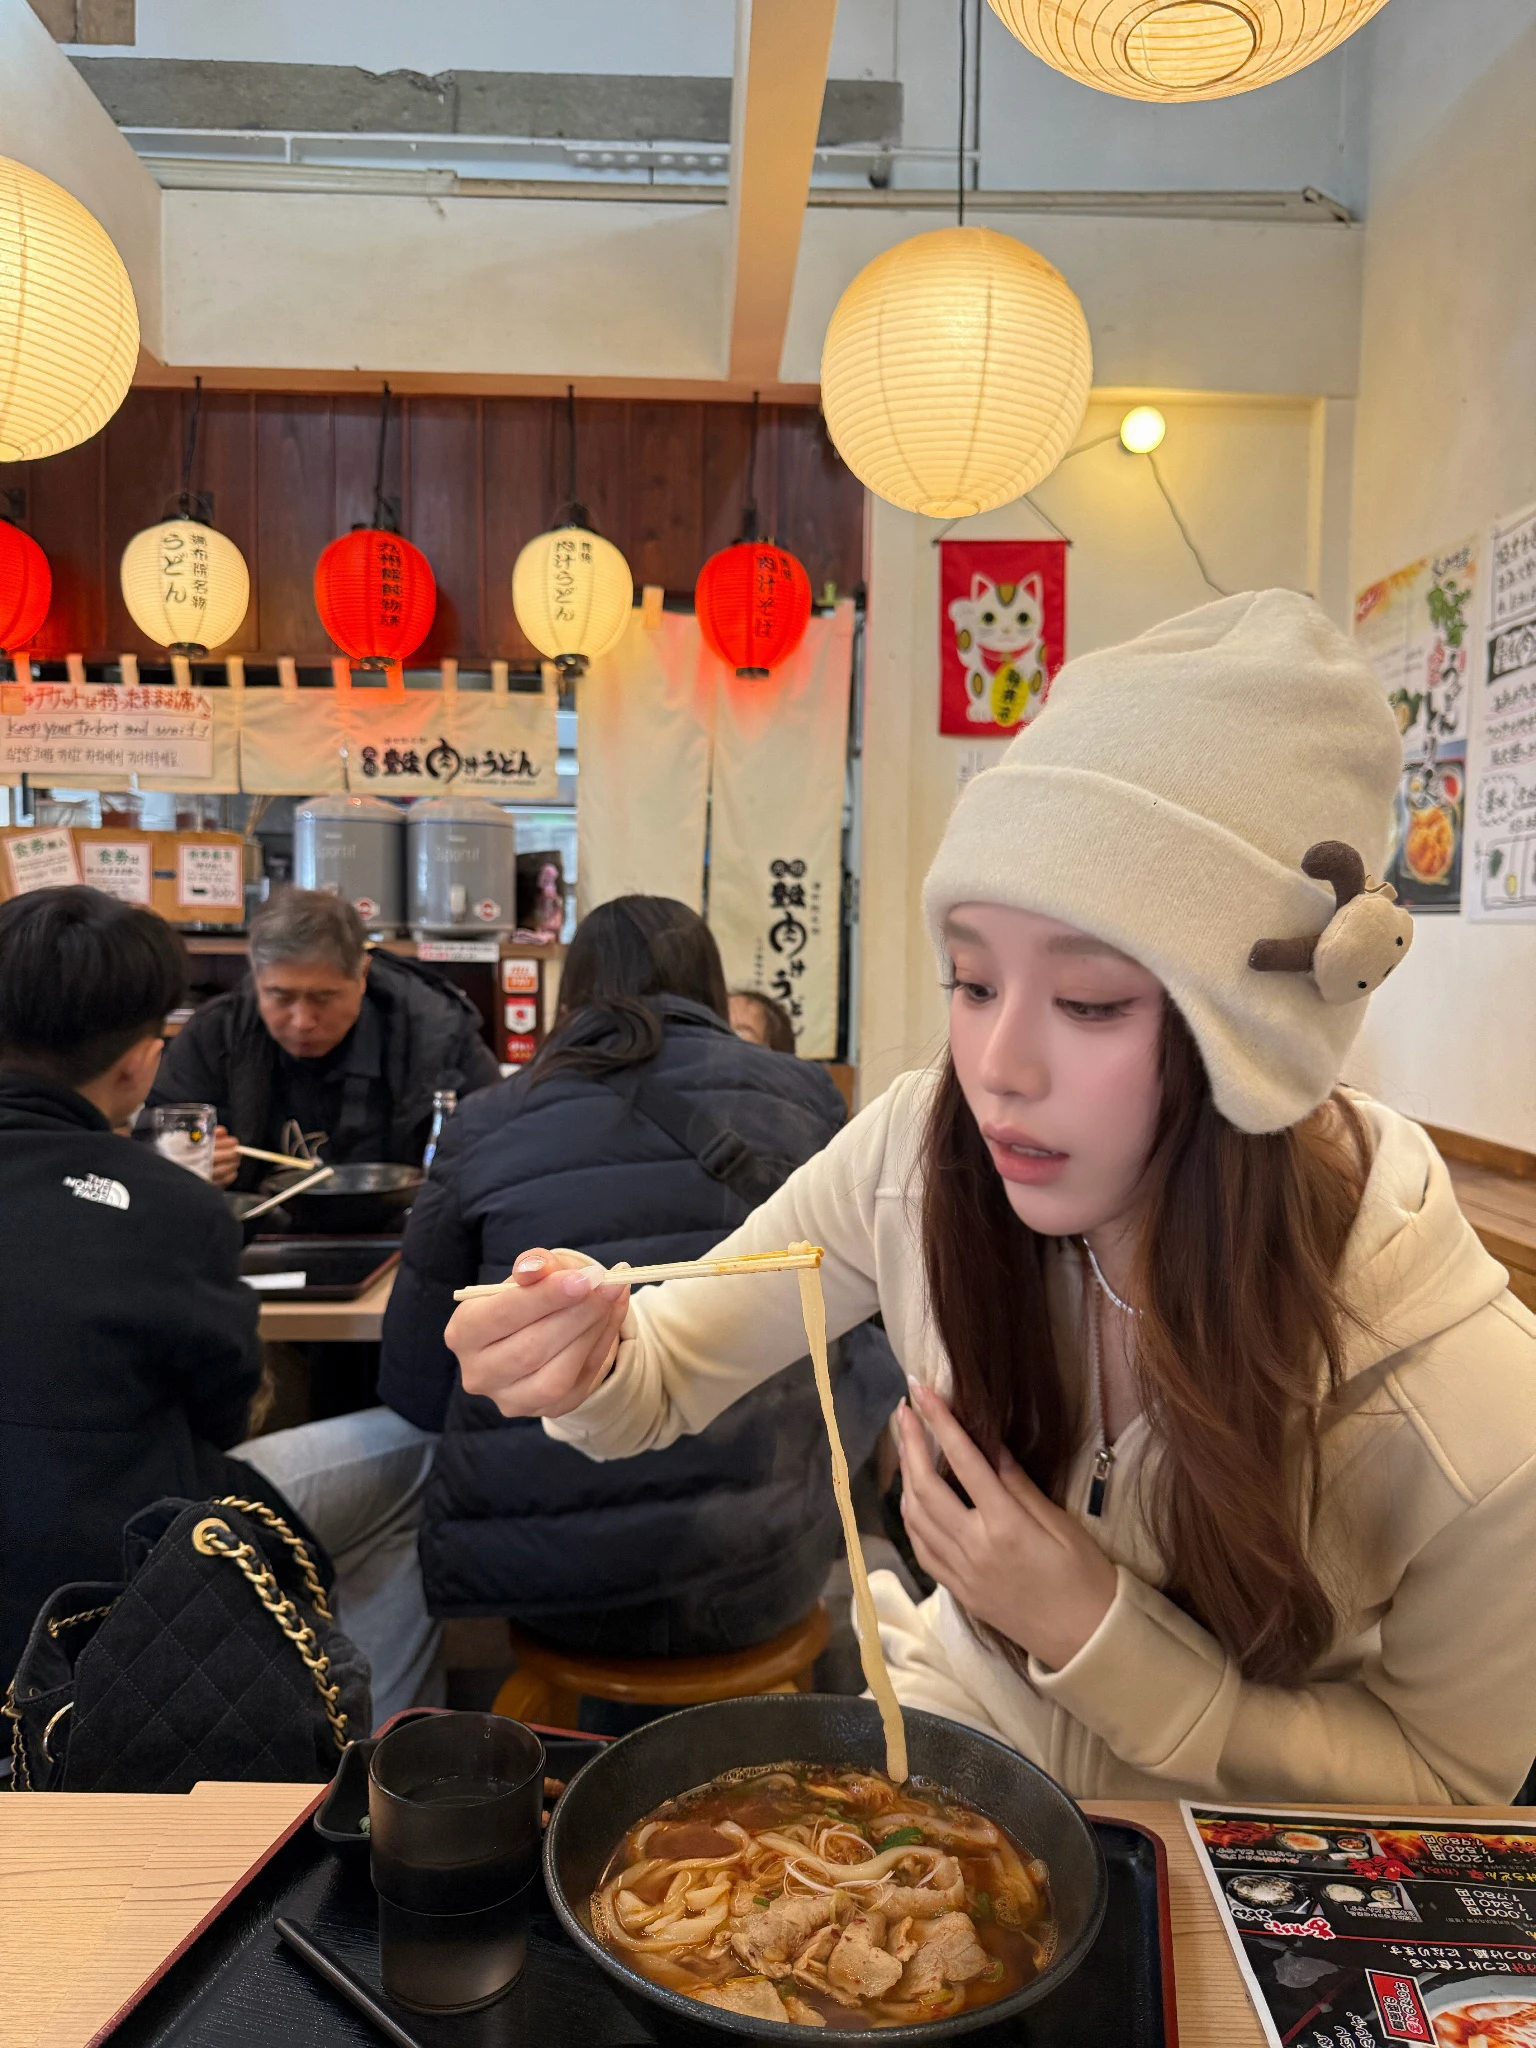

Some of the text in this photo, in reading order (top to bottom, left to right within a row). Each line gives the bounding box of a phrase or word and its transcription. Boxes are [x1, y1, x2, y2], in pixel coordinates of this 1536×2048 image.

[161, 533, 188, 603] うどん
[553, 541, 576, 622] 肉汁うどん
[125, 718, 149, 737] and
[1231, 1908, 1273, 1922] うどん
